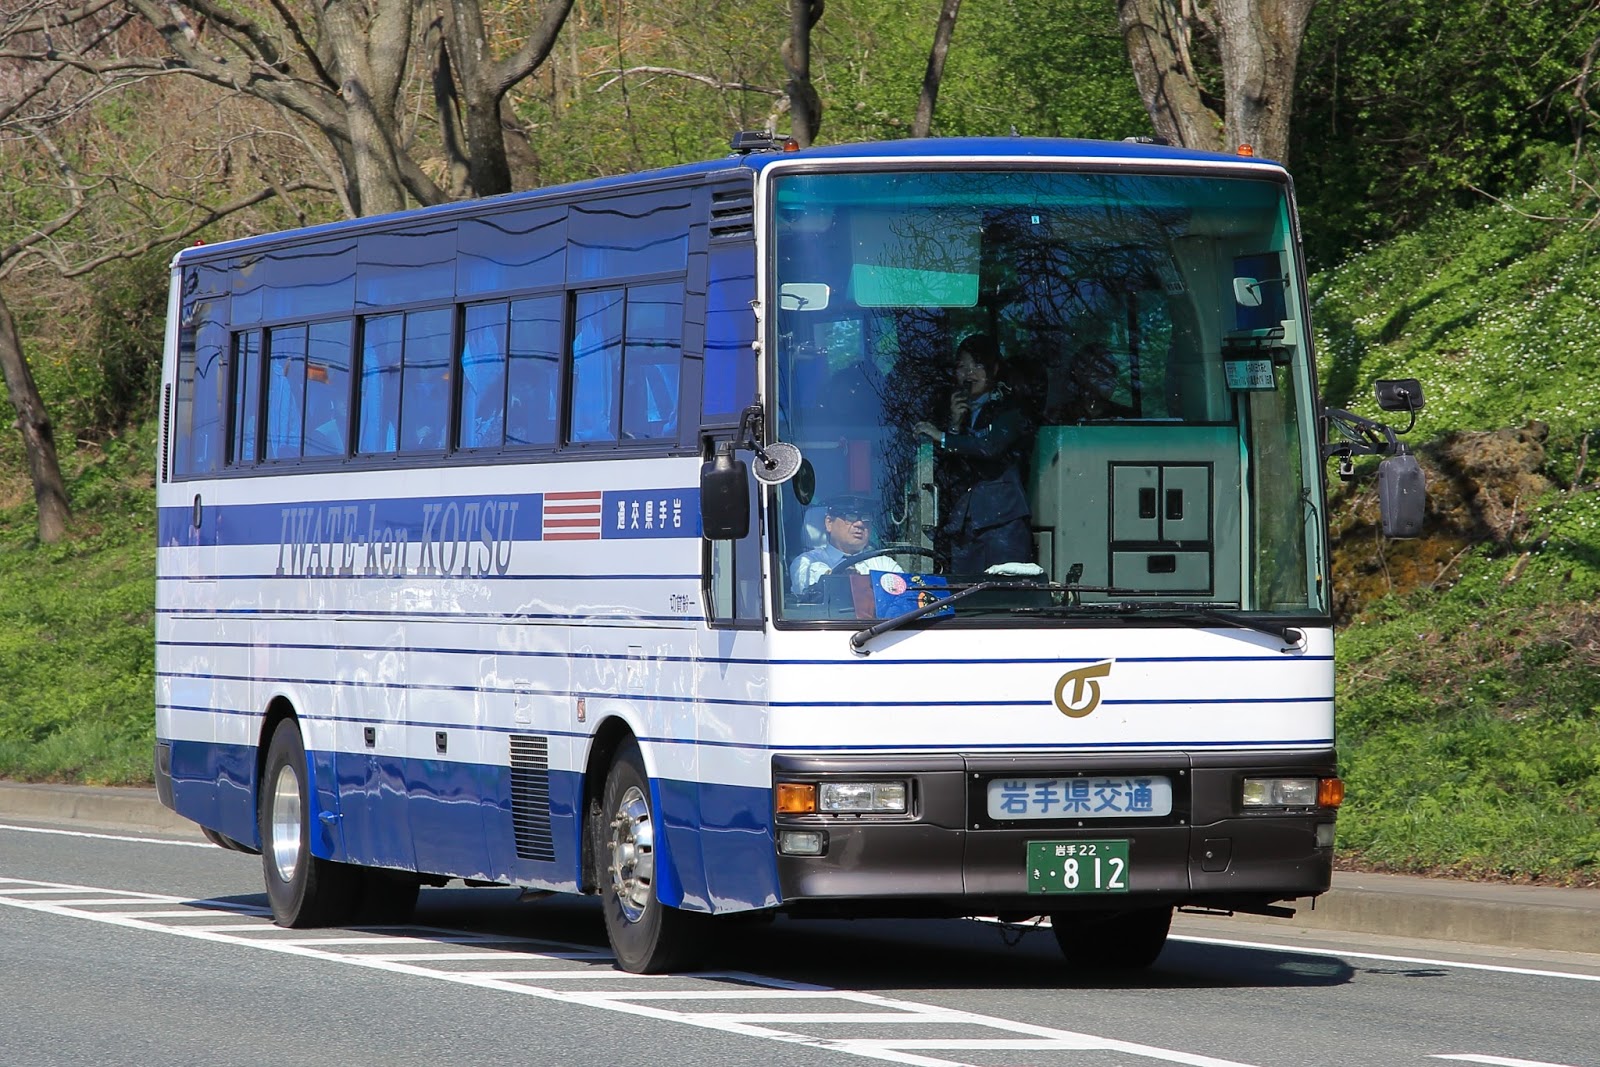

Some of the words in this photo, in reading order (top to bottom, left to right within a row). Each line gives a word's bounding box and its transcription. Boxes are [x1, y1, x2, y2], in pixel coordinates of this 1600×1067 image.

[275, 503, 408, 577] IWATE-ken
[416, 500, 520, 578] KOTSU
[1000, 779, 1154, 814] 岩手県交通
